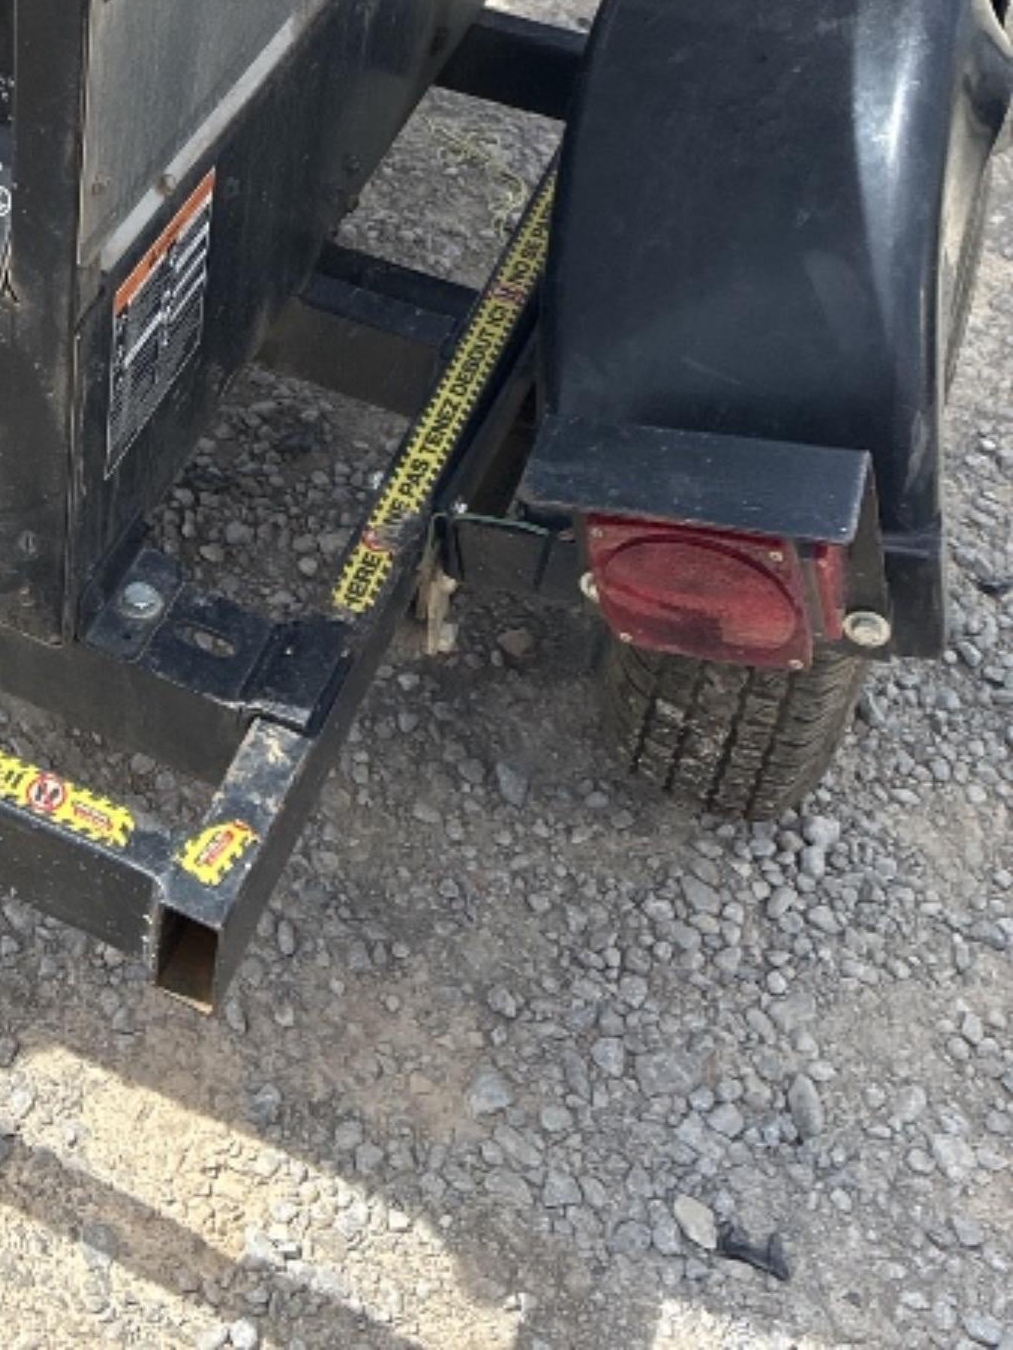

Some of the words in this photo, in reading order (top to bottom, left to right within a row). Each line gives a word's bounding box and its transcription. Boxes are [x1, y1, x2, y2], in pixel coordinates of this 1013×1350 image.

[398, 458, 430, 497] PAS
[417, 397, 462, 454] TENEZ
[449, 329, 497, 397] DEBOUT
